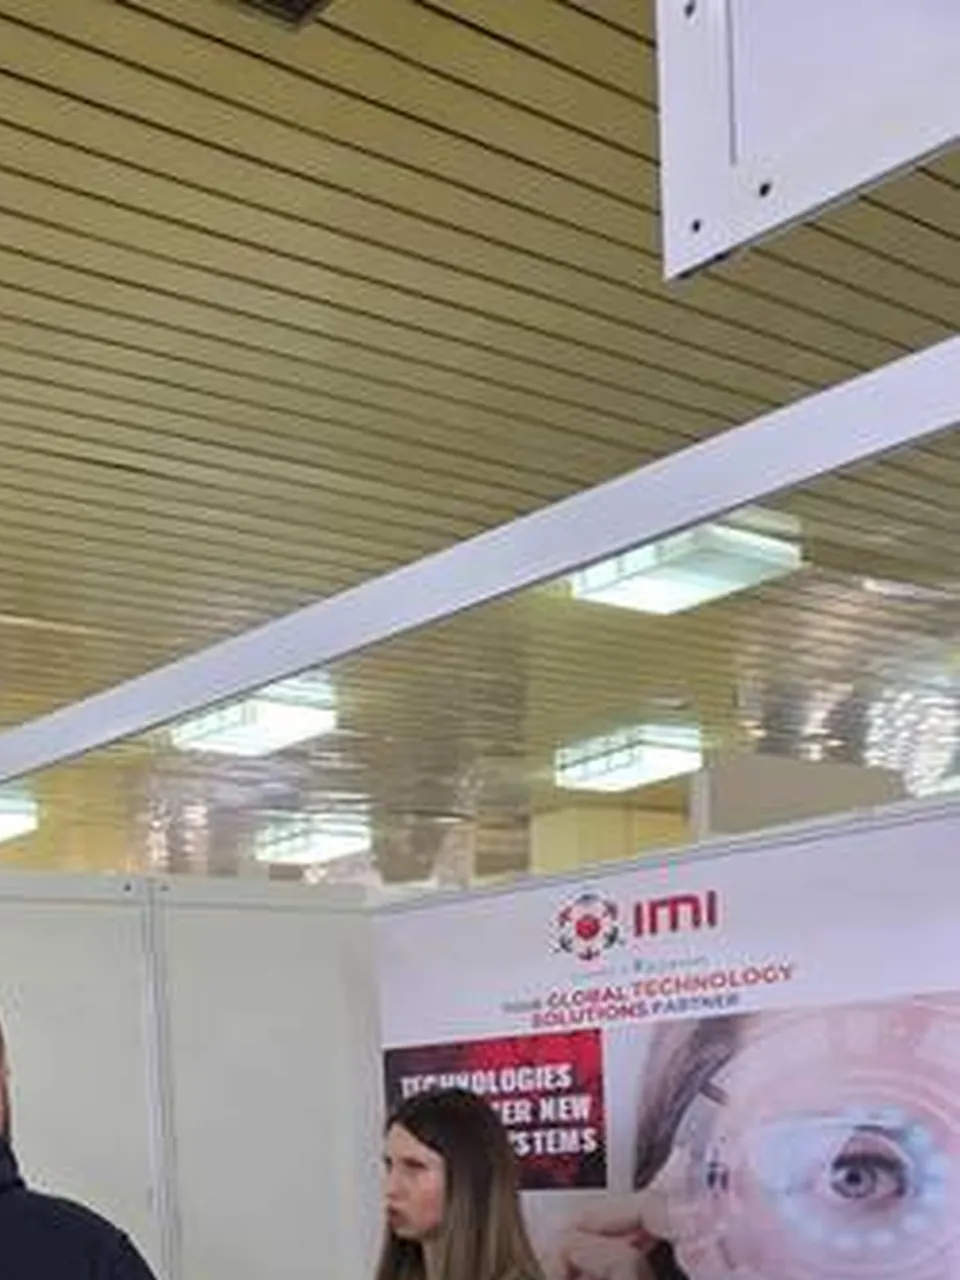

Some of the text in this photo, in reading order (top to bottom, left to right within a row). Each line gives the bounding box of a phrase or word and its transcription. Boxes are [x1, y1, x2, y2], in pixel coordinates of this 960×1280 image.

[546, 984, 627, 1008] GLOBAL
[632, 963, 794, 998] TECHNOLOGY
[532, 1001, 649, 1028] SOLUTIONS
[651, 994, 740, 1015] PARTNER
[400, 1063, 573, 1099] TECHNOLOGIES
[491, 1093, 591, 1125] ER NEW
[507, 1126, 599, 1156] STEMS
